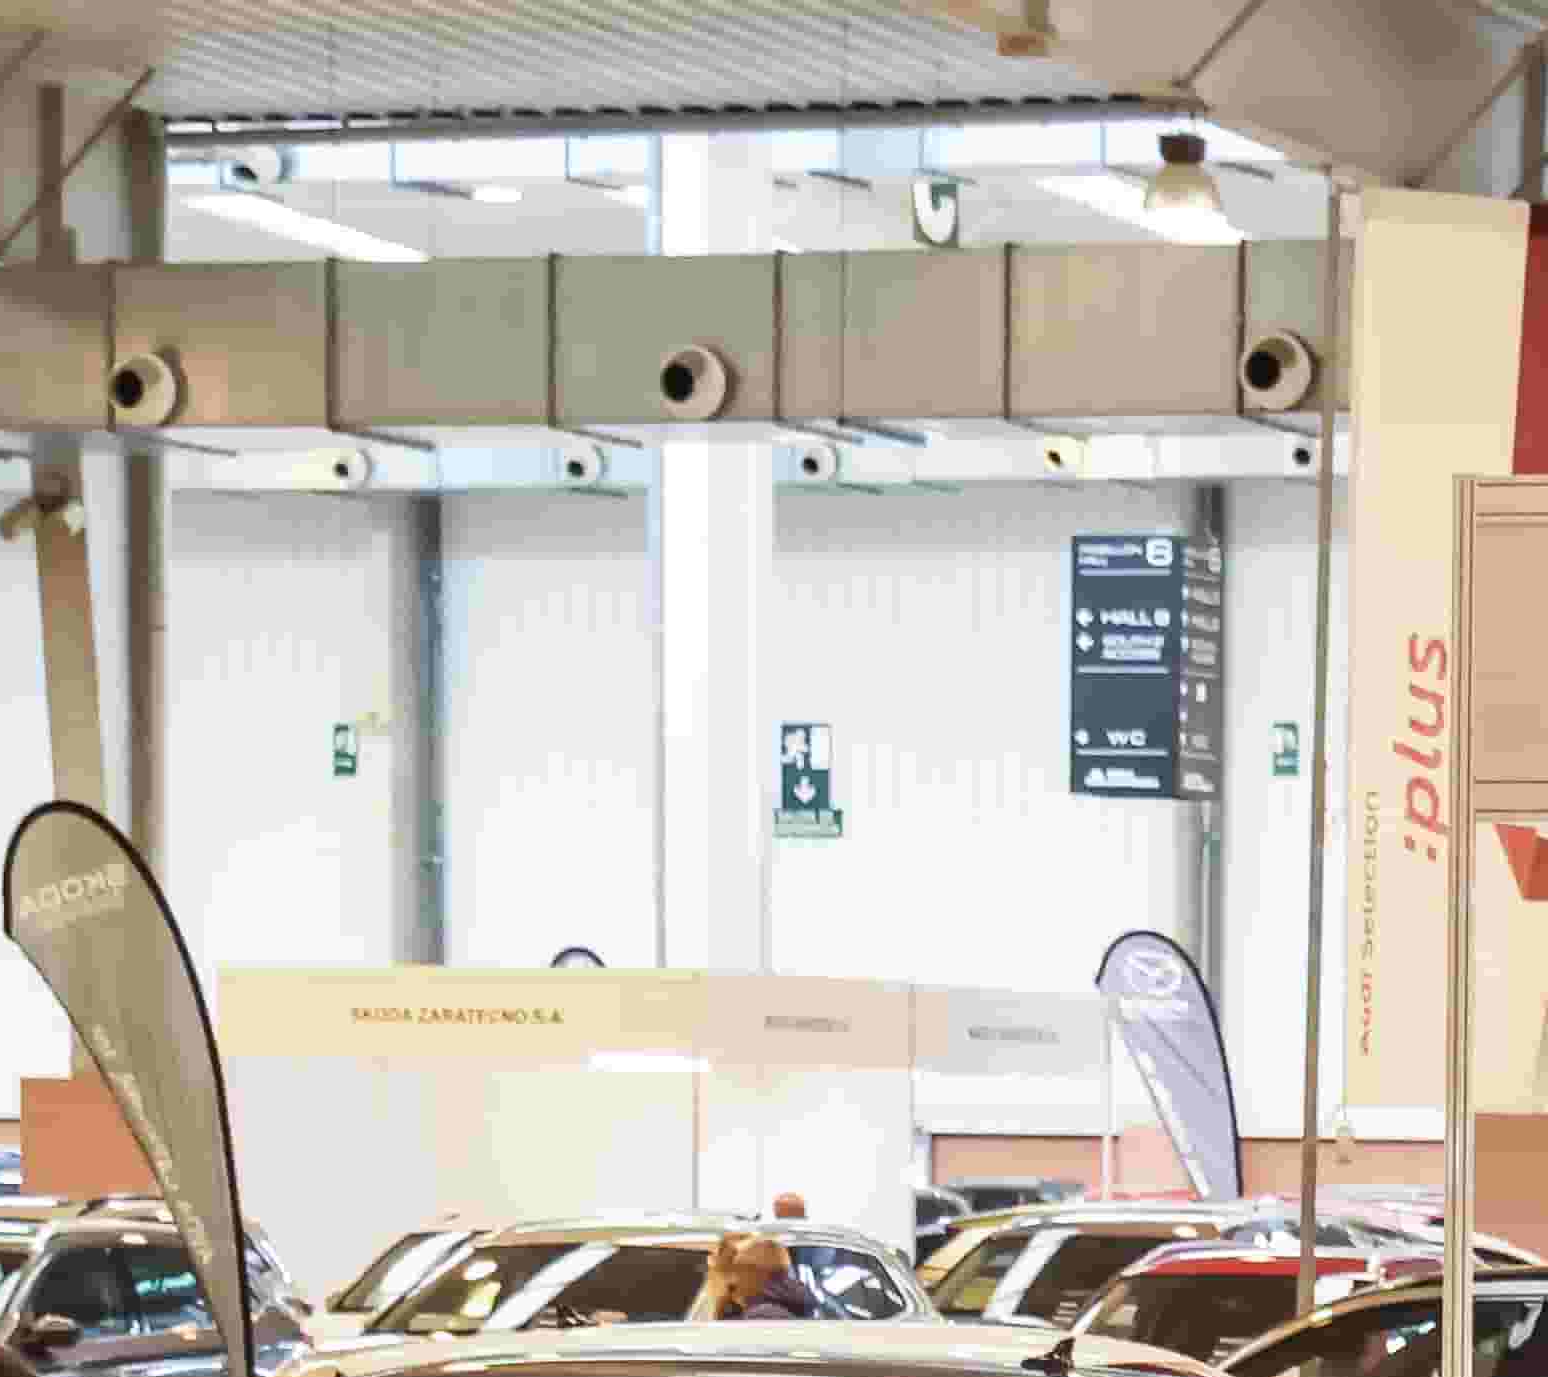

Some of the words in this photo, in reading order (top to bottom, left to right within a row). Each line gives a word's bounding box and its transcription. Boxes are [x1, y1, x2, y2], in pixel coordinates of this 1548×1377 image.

[1106, 730, 1147, 747] WC
[1393, 633, 1451, 861] :plus
[1361, 790, 1378, 960] Selection
